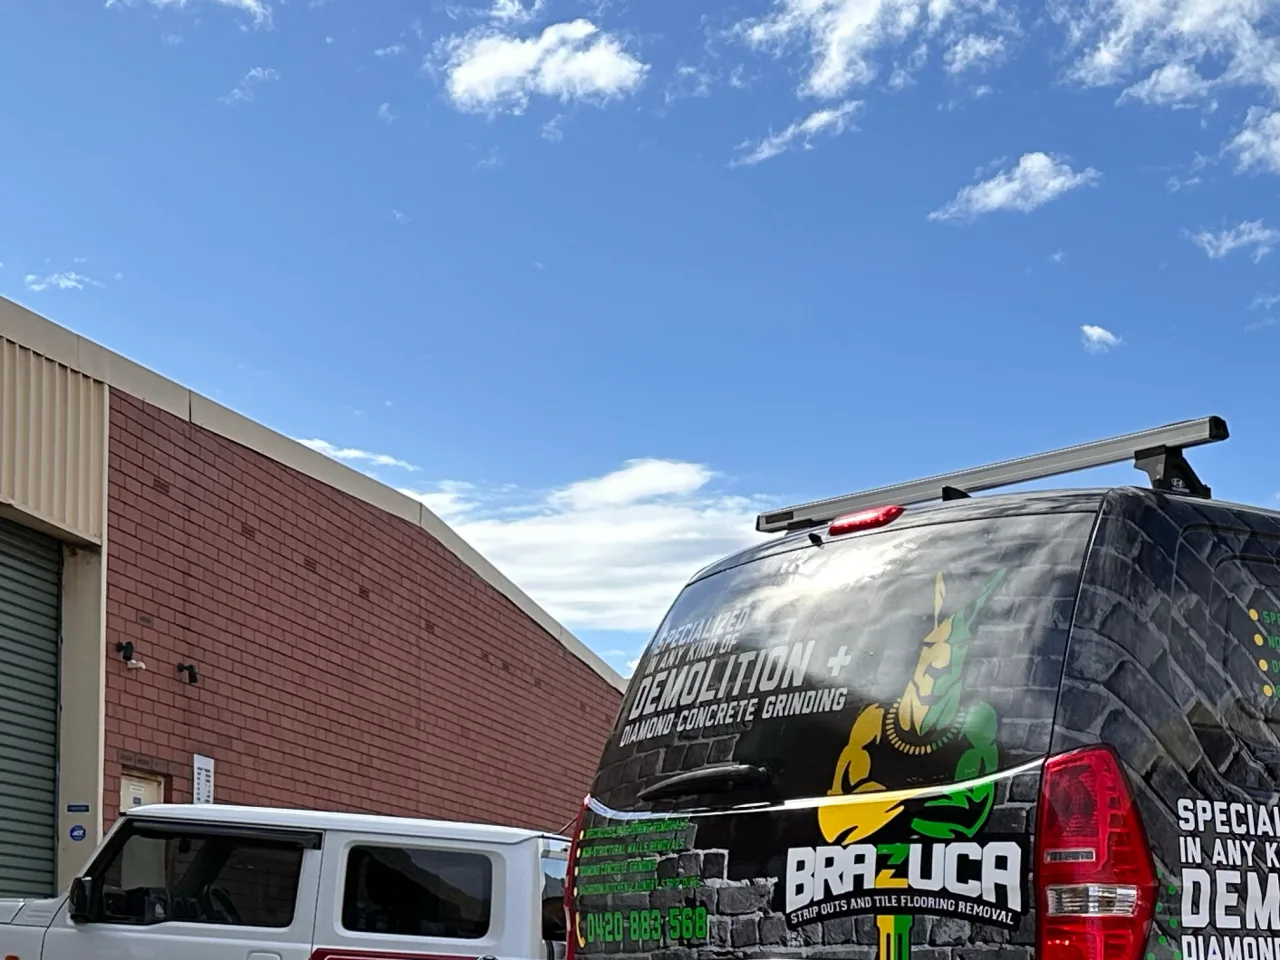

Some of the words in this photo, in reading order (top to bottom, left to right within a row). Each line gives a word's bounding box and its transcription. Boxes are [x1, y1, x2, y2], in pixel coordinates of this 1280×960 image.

[657, 607, 750, 652] SPECIALIZED
[658, 648, 688, 671] ANY
[686, 639, 719, 664] KIND
[719, 632, 741, 653] OF
[628, 639, 815, 721] DEMOLITION
[619, 709, 675, 748] DIAMOND
[676, 698, 758, 733] CONCRETE
[762, 687, 848, 720] GRINDING
[1179, 836, 1200, 864] IN
[1212, 837, 1255, 866] ANY
[785, 841, 1022, 914] BRAZUCA
[586, 911, 623, 943] 0420
[630, 908, 662, 941] 883
[668, 906, 708, 940] 568
[790, 906, 819, 924] STRIP
[821, 900, 848, 919] OUTS
[850, 896, 872, 911] AND
[874, 895, 898, 907] TILE
[901, 895, 956, 912] FLOORING
[957, 901, 1015, 925] REMOVAL
